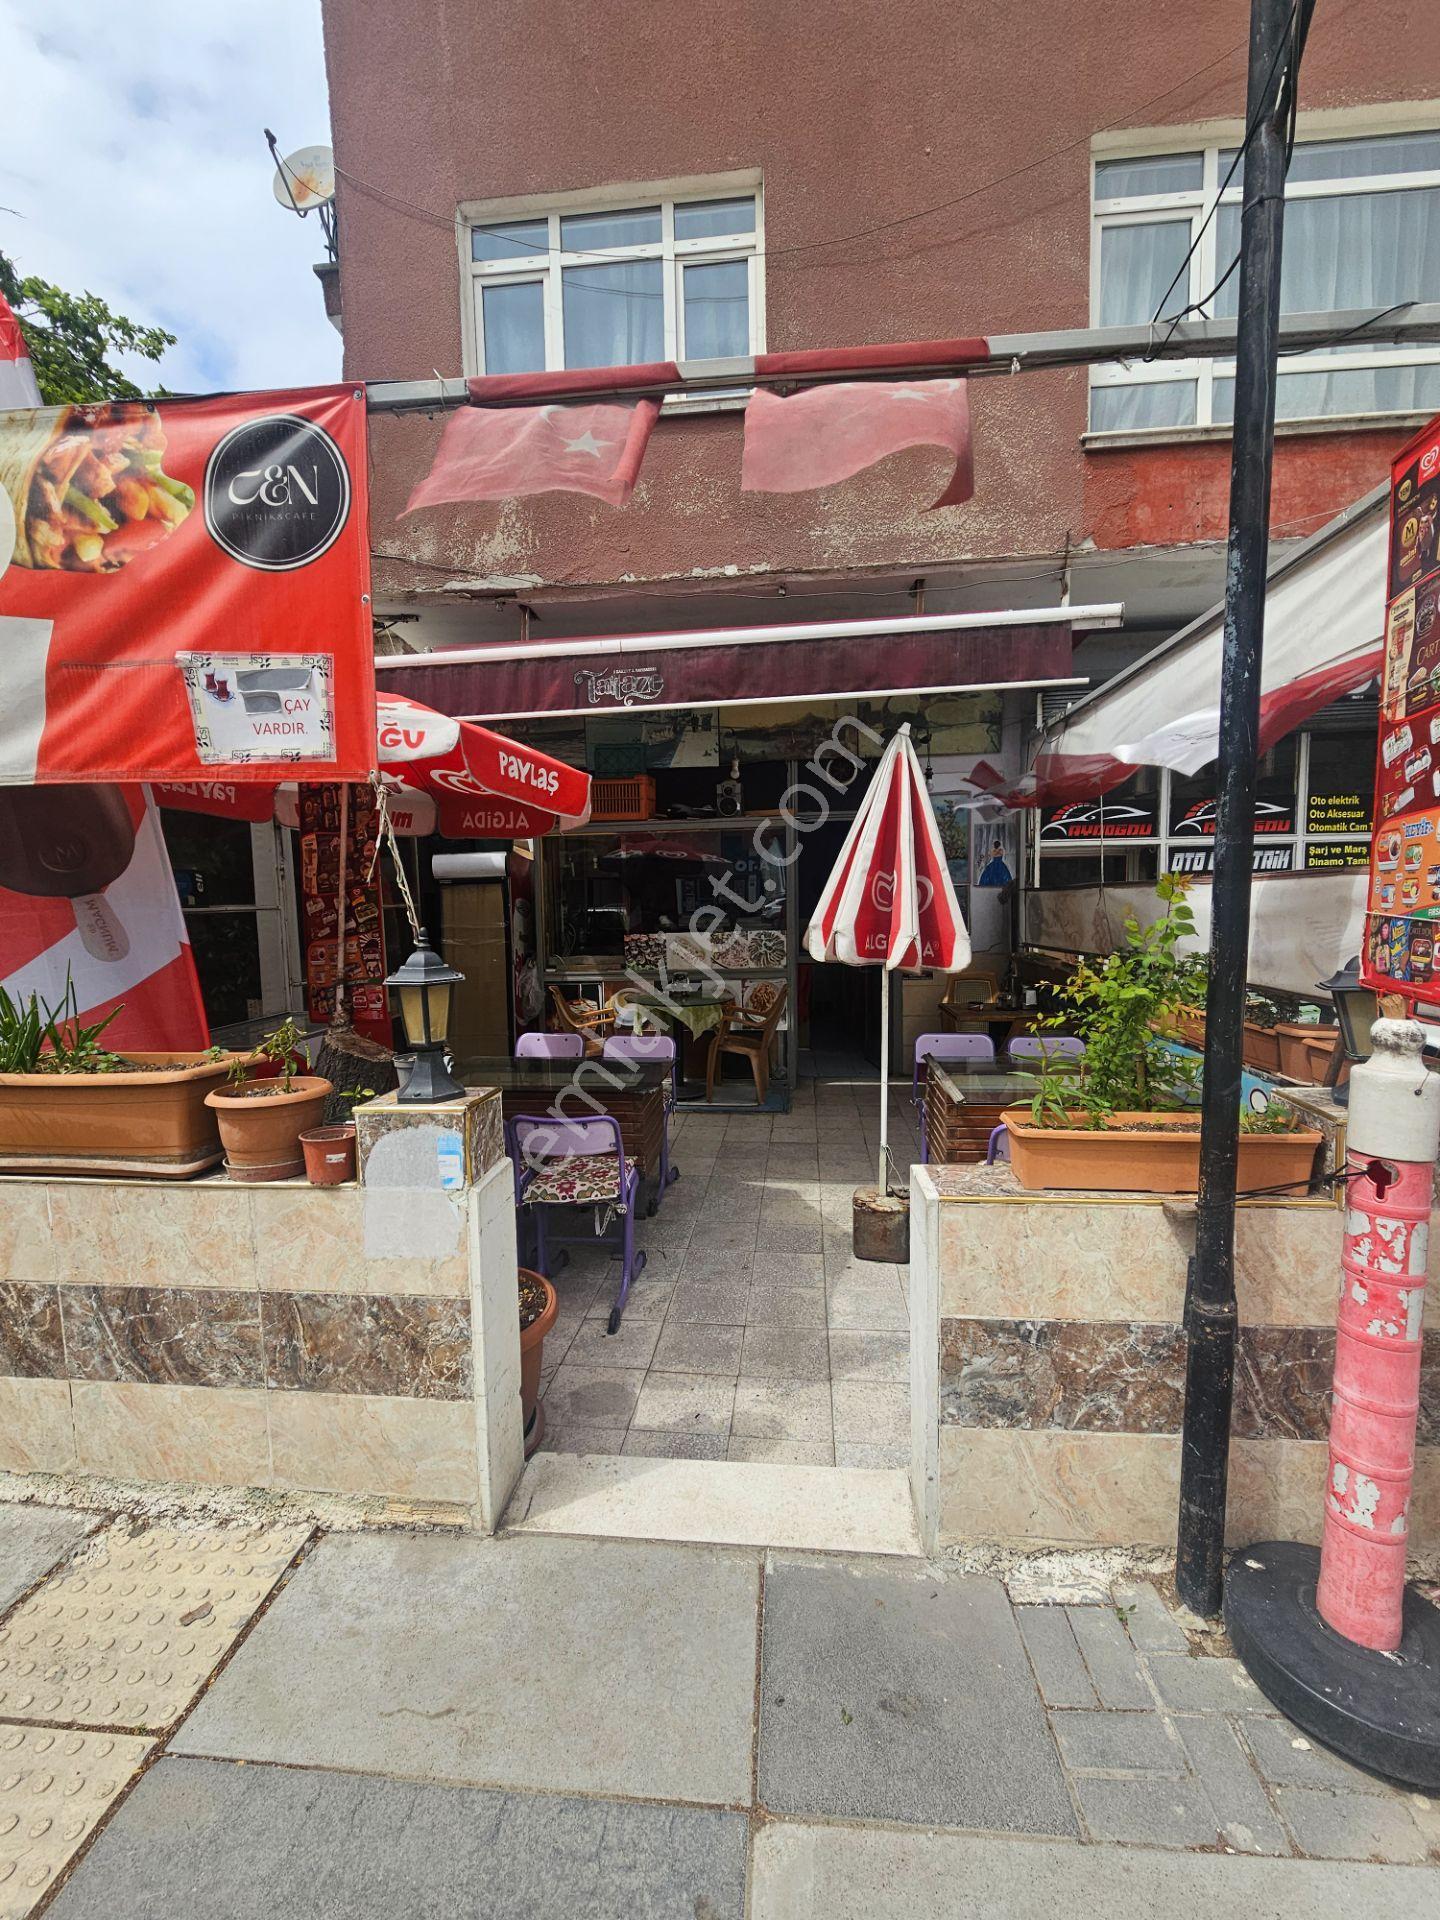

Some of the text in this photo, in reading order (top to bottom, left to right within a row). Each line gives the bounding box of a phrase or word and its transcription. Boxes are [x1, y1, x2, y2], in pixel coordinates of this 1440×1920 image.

[228, 464, 319, 507] C&N
[284, 699, 311, 714] ÇAY
[252, 722, 309, 735] VARDIR.
[378, 721, 426, 749] ĞU
[1310, 795, 1360, 805] Oto elektrik
[1309, 808, 1365, 819] Oto Aksesuar
[1309, 822, 1347, 832] Otomatik
[1349, 822, 1368, 831] Cam
[1309, 846, 1328, 856] Şarj
[1344, 845, 1367, 855] Marş
[1171, 852, 1206, 871] OTO
[1309, 858, 1344, 866] Dinamo
[865, 933, 935, 957] ALGA
